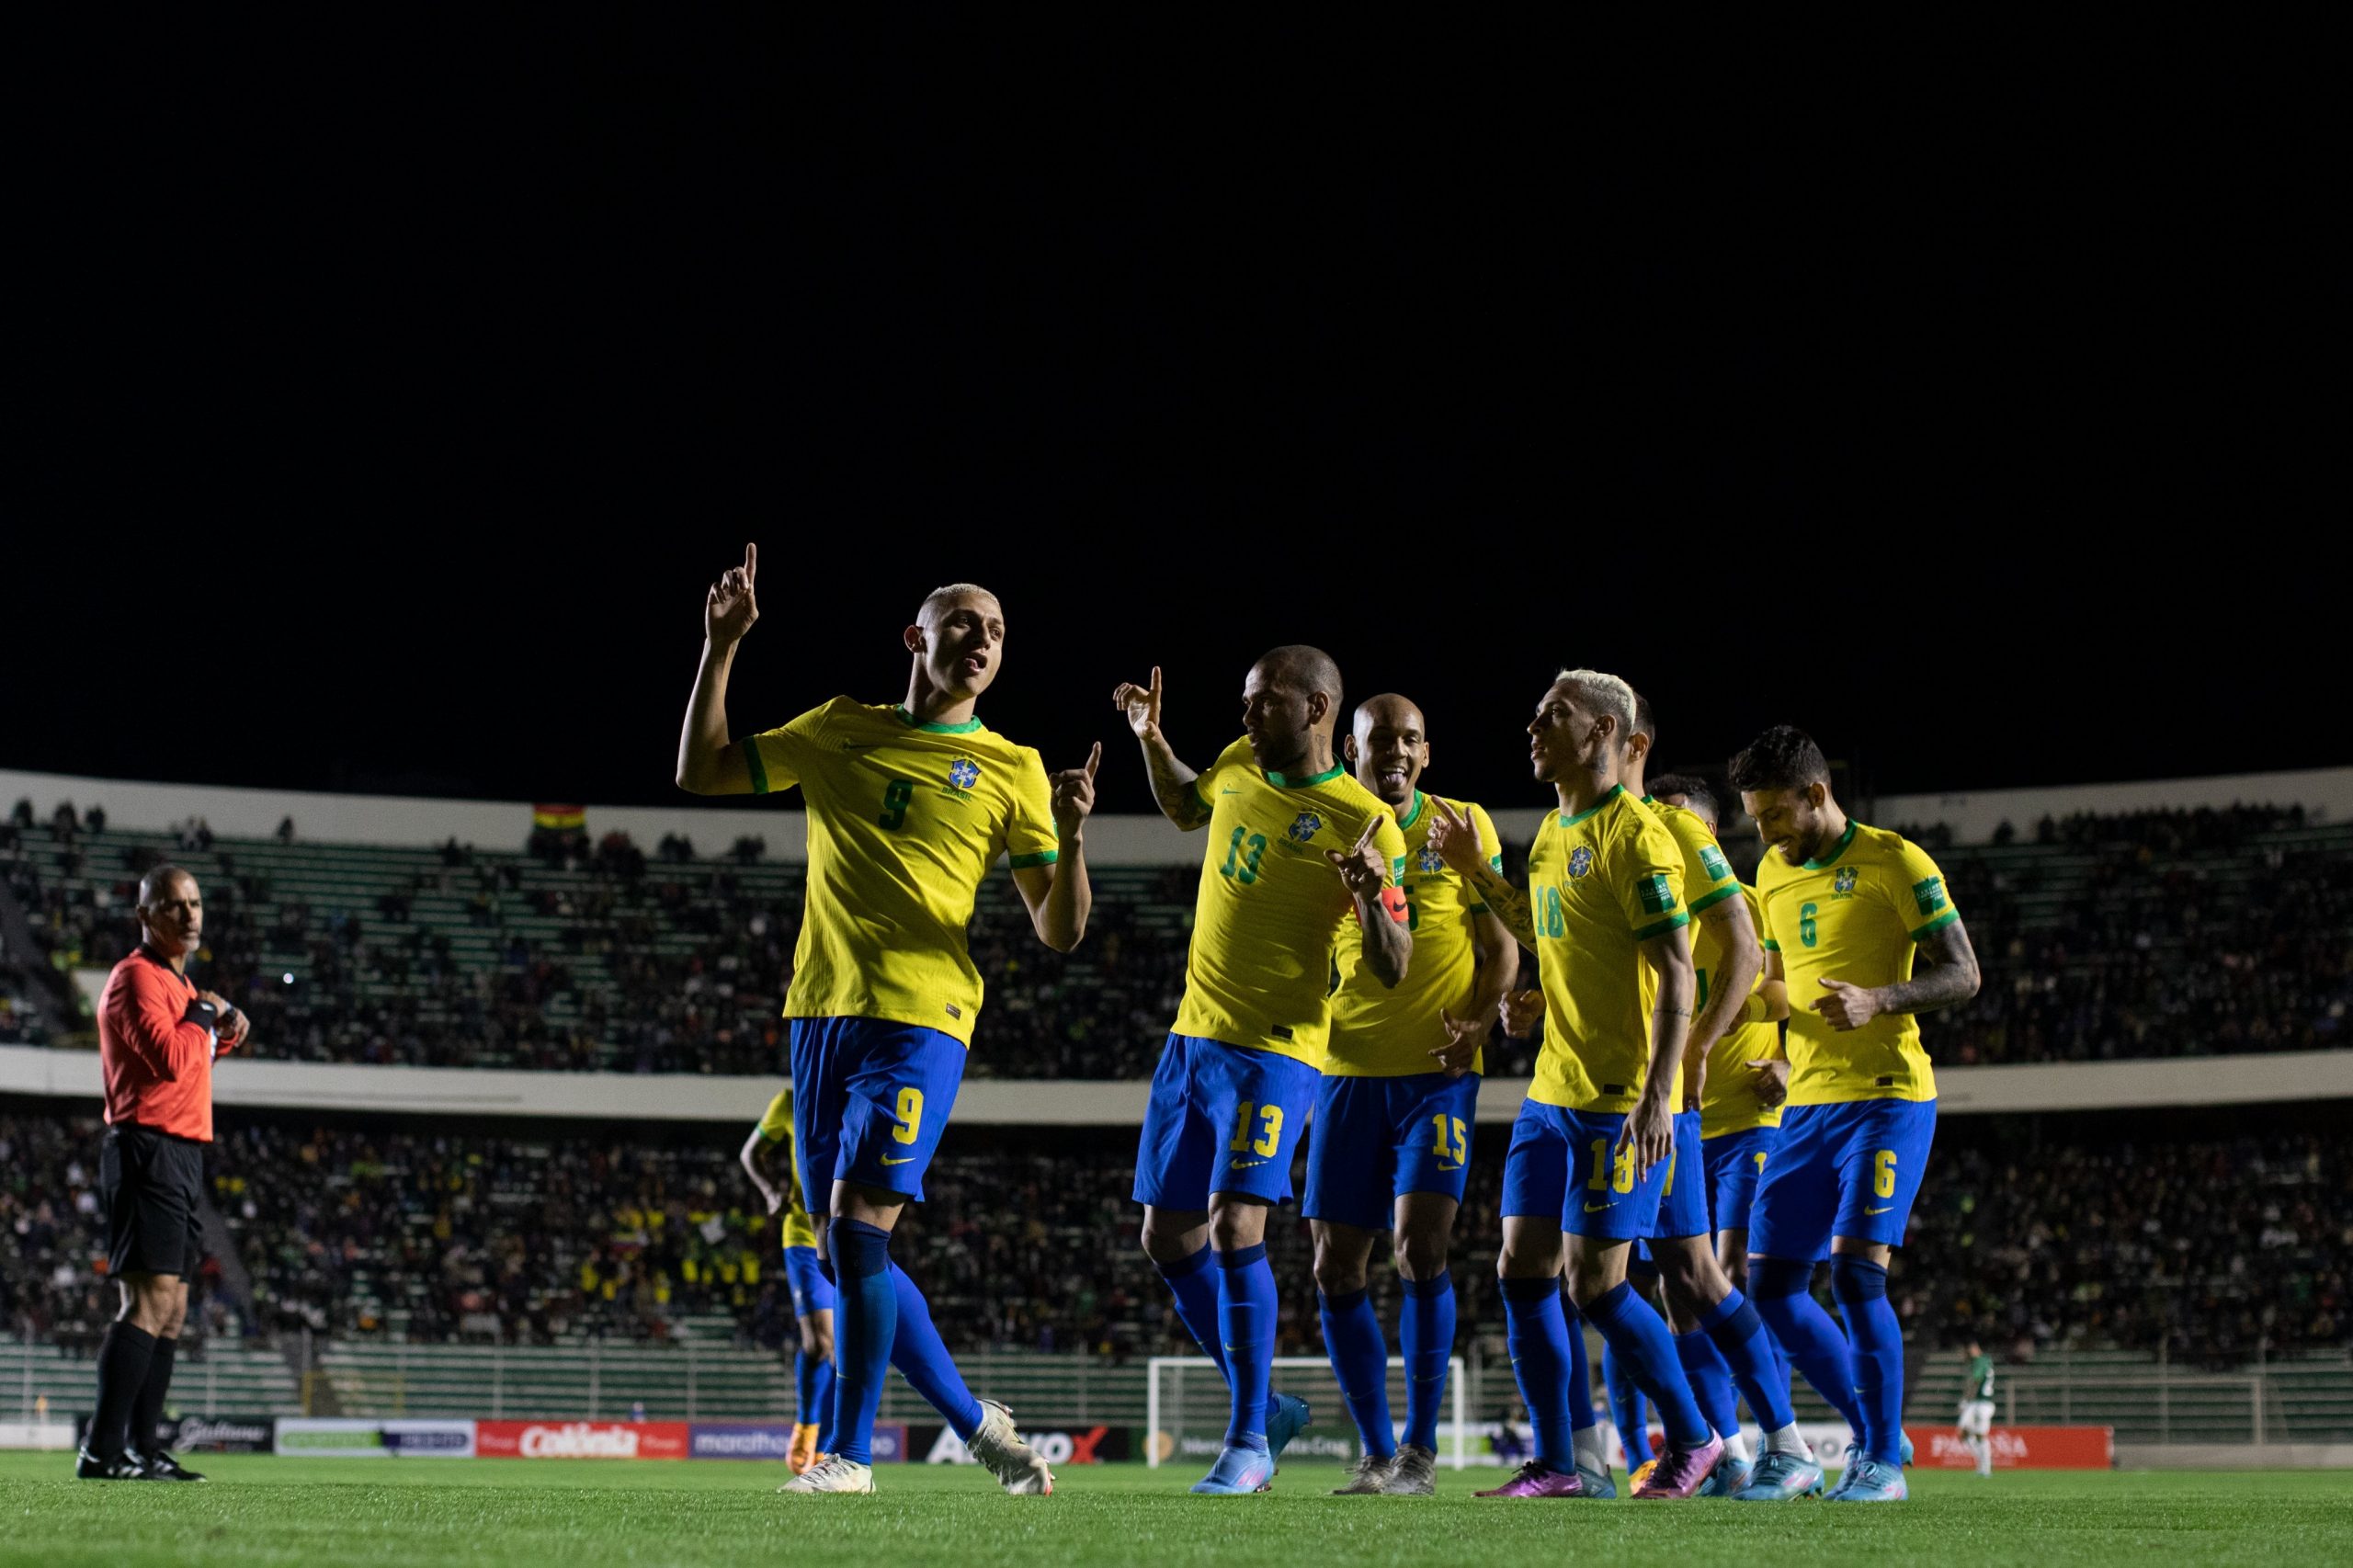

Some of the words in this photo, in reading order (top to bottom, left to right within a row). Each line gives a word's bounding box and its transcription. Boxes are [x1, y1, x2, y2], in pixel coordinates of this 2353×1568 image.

[879, 778, 913, 831] 9
[941, 786, 972, 802] BRASIL
[1221, 825, 1267, 885] 13
[1536, 885, 1564, 939] 18
[1800, 902, 1818, 949] 6
[892, 1086, 925, 1146] 9
[1230, 1100, 1284, 1159] 13
[1432, 1113, 1467, 1167] 15
[1587, 1139, 1636, 1194] 18
[1873, 1149, 1898, 1199] 6
[694, 1431, 792, 1454] maratho
